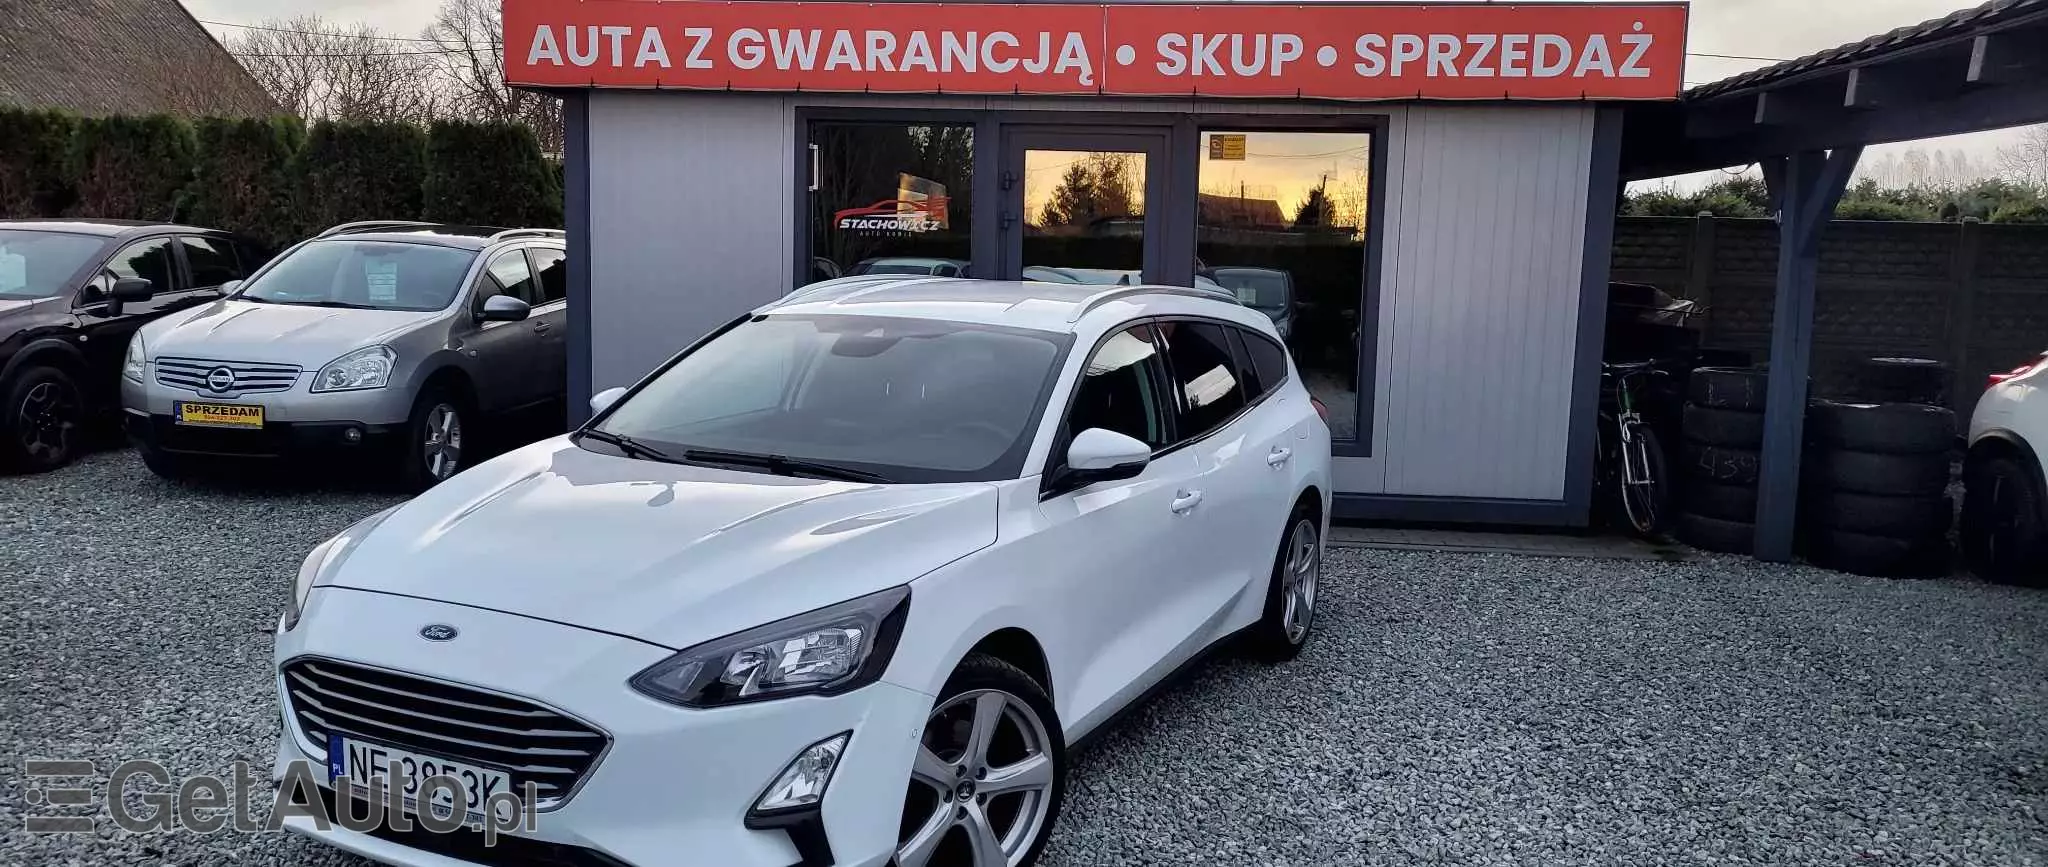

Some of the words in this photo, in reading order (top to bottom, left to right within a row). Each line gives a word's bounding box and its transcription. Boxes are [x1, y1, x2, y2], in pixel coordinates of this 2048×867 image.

[526, 24, 672, 68] AUTA
[684, 27, 713, 69] Z
[727, 27, 1094, 86] GWARANCJĄ
[1156, 33, 1303, 77] SKUP
[1354, 21, 1654, 78] SPRZEDAŻ
[840, 219, 940, 231] STACHOWICZ
[185, 404, 260, 417] SPRZEDAM
[333, 763, 343, 775] PL
[350, 743, 388, 788] NE
